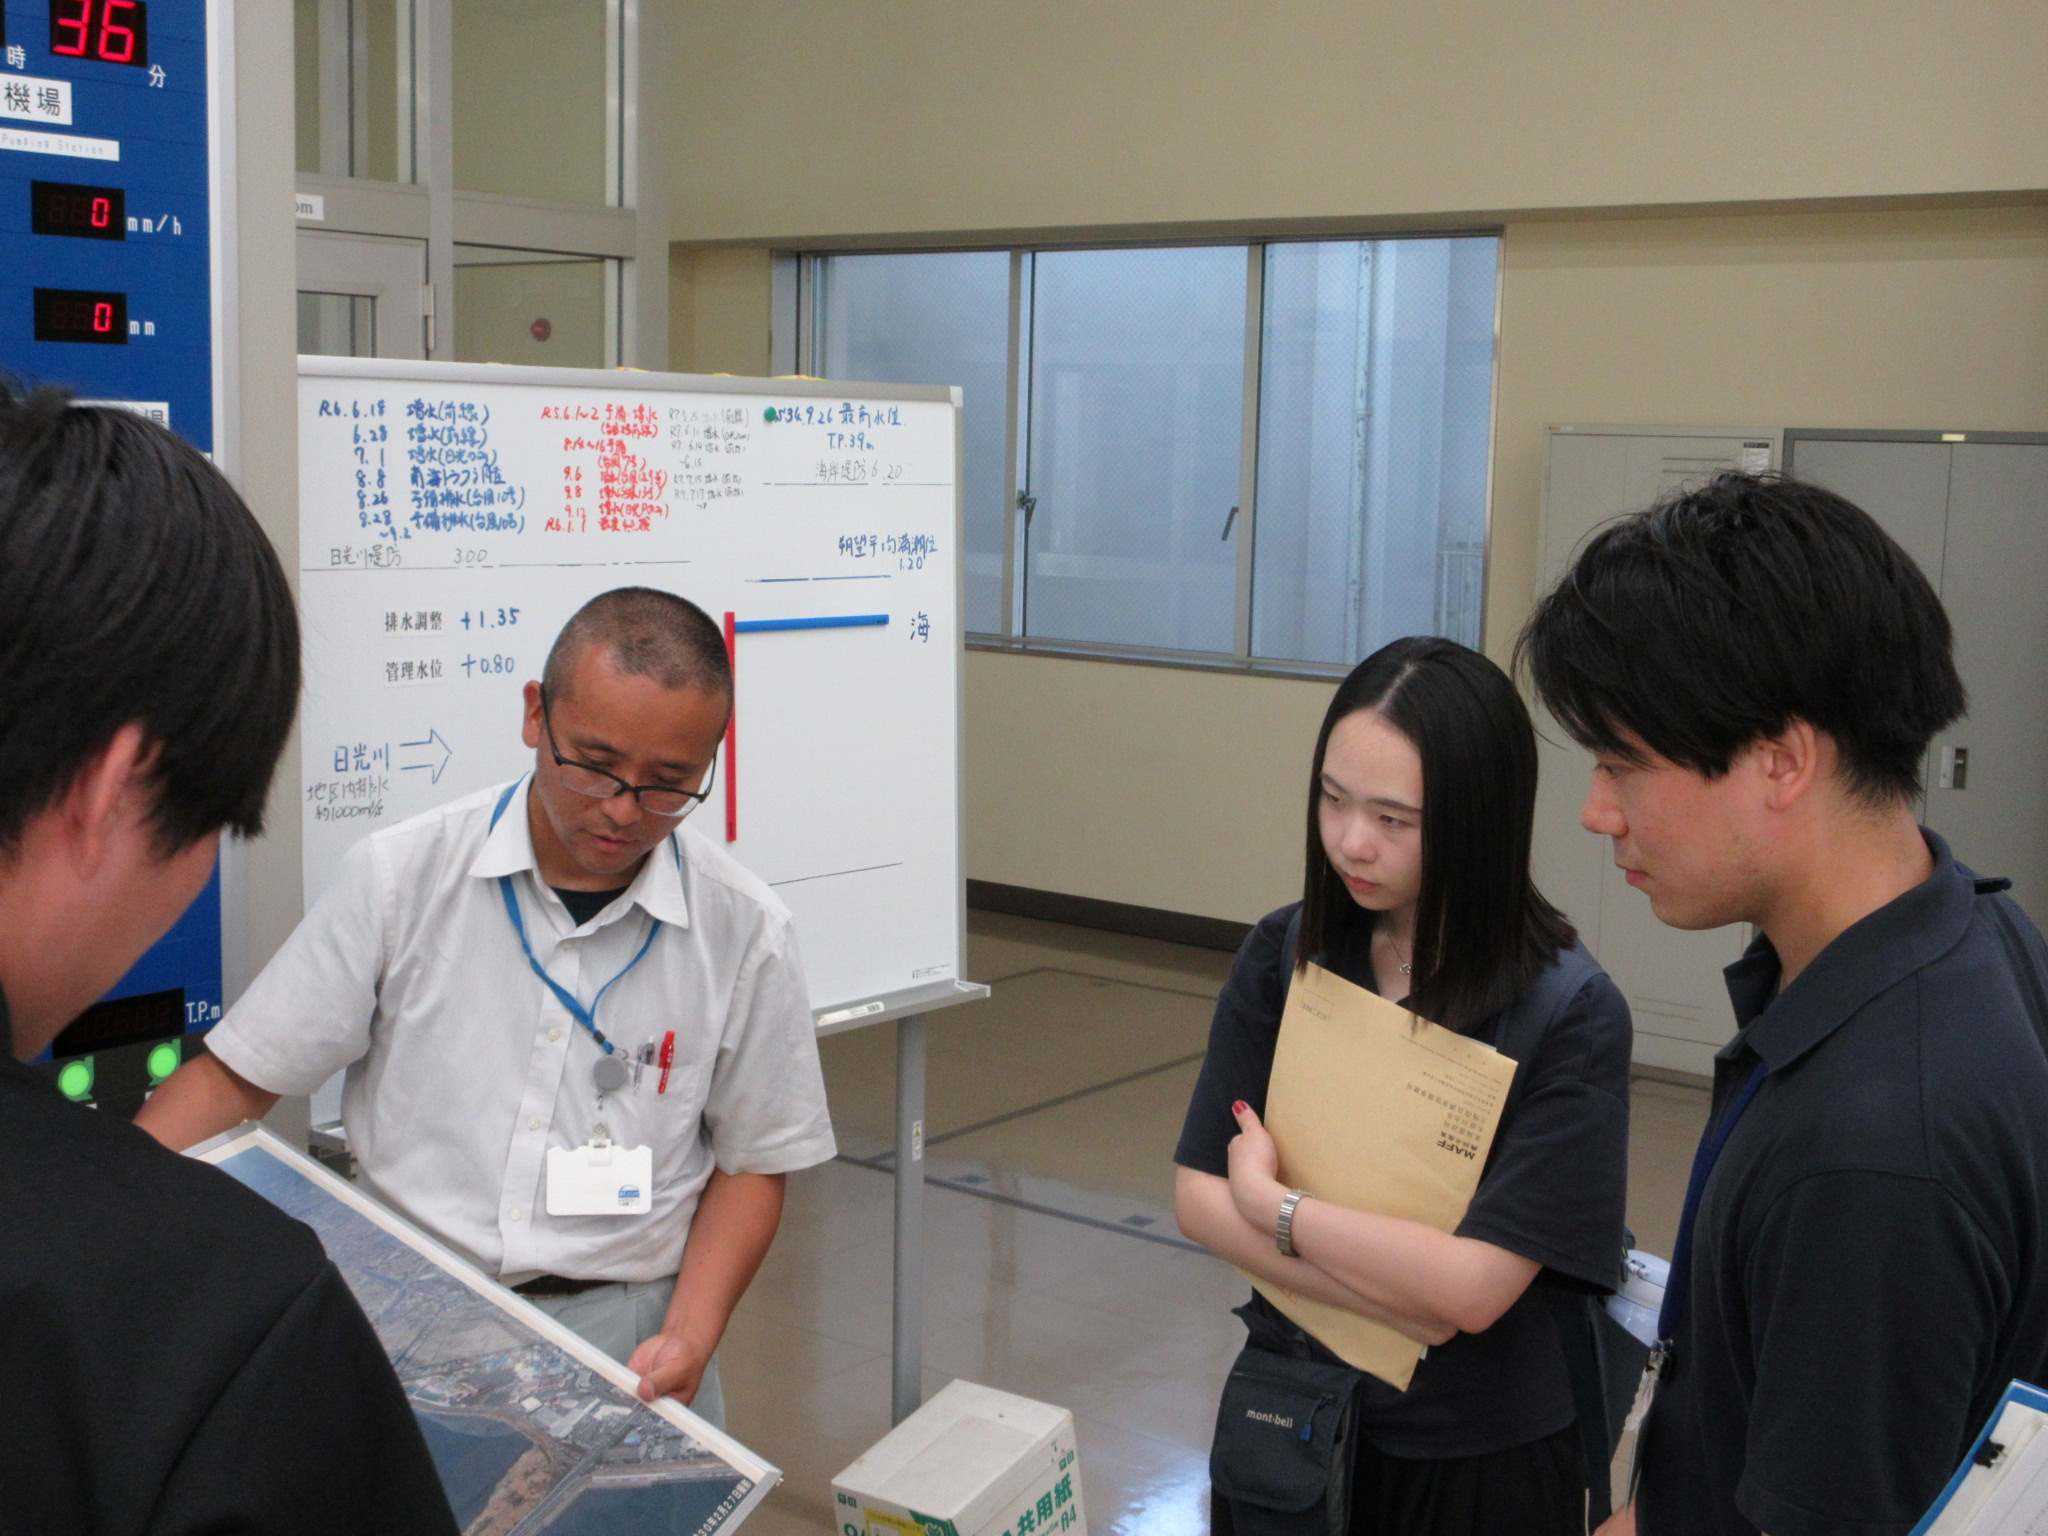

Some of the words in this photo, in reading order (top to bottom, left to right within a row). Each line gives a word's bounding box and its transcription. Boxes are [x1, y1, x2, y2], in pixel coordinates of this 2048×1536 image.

[52, 0, 137, 63] 36
[6, 45, 26, 70] 時
[148, 64, 167, 89] 分
[3, 81, 62, 118] 機場
[91, 197, 110, 228] 0
[127, 213, 183, 237] mm/h
[94, 302, 113, 333] 0
[129, 318, 156, 337] mm
[384, 611, 443, 633] 排水調整
[910, 610, 931, 643] 海
[384, 658, 444, 683] 管理水位
[333, 742, 390, 773] 日光川
[1436, 1138, 1476, 1161] MAFF
